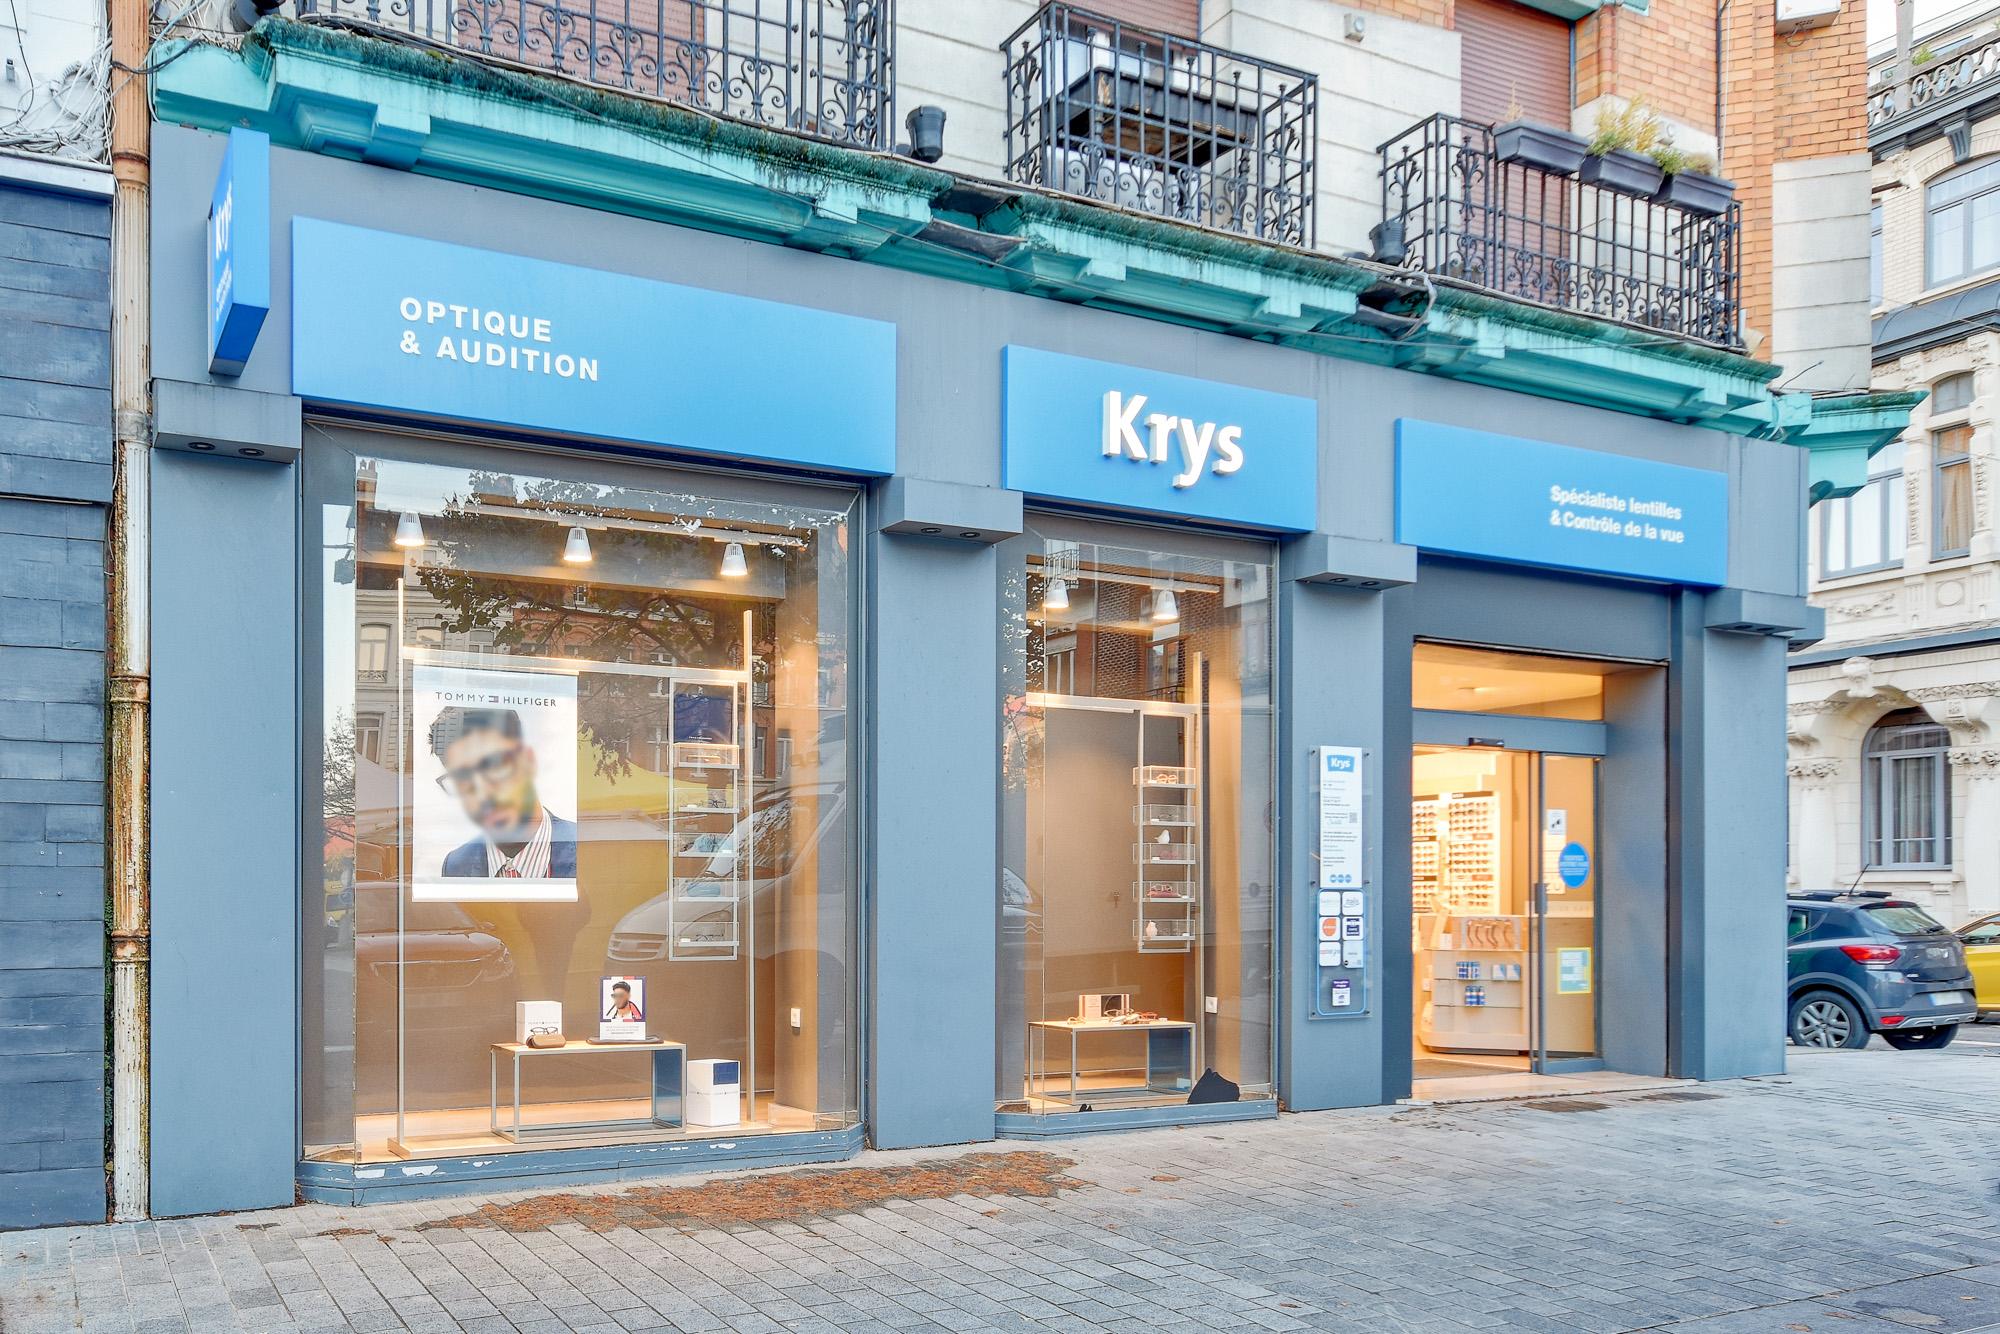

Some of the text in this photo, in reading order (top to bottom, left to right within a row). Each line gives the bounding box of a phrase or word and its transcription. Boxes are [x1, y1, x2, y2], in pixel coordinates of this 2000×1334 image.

[400, 297, 551, 342] OPTIQUE
[400, 330, 598, 381] & AUDITION
[1103, 391, 1243, 488] Krys
[1551, 485, 1682, 520] Spécialiste lentilles
[1563, 511, 1621, 534] Contrôle
[1624, 520, 1641, 537] de
[1644, 523, 1657, 539] la
[1660, 528, 1684, 543] vue
[436, 692, 556, 707] TOMMY HILFIGER
[1331, 757, 1351, 770] Krys
